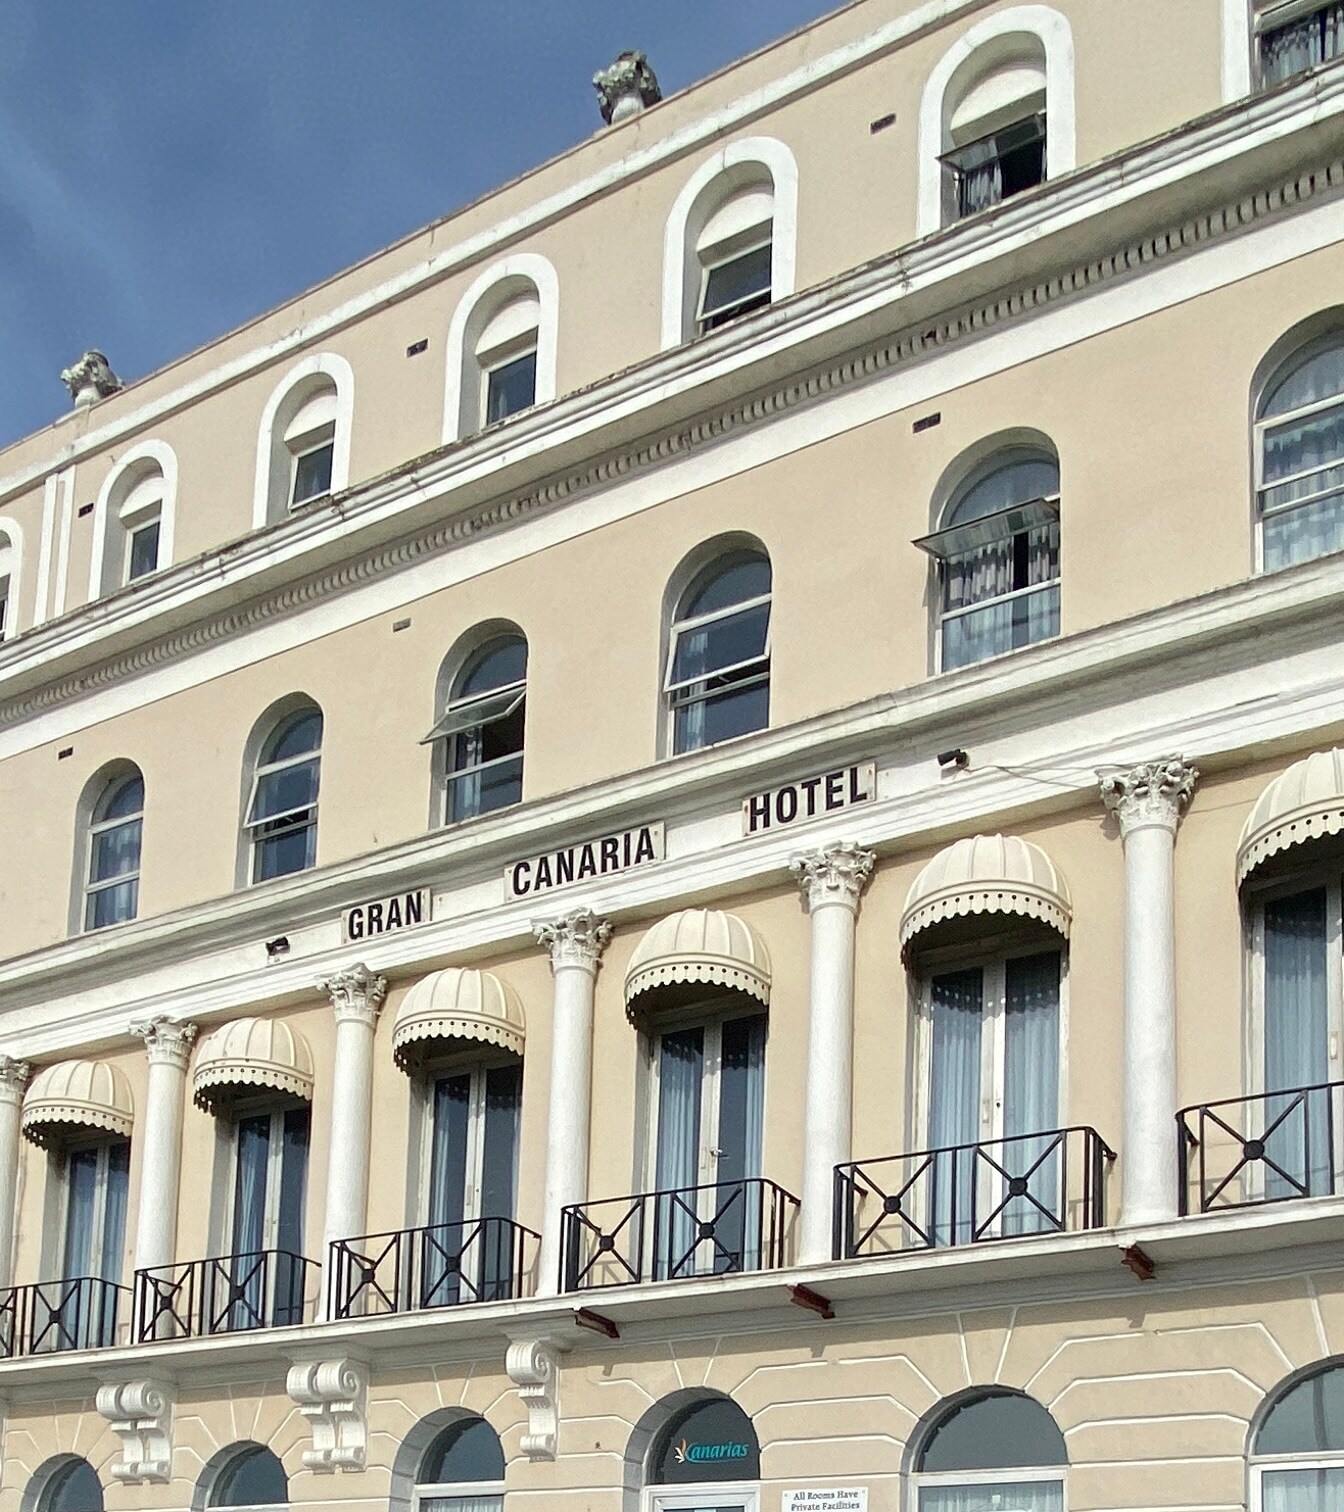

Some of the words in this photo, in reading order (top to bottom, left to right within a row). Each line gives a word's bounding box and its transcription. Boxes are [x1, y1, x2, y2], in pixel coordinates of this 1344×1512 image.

[347, 890, 424, 941] GRAN
[512, 828, 655, 896] CANARIA
[749, 767, 868, 833] HOTEL
[685, 1441, 749, 1464] Canarias
[793, 1492, 805, 1500] All
[807, 1492, 835, 1500] Rooms
[837, 1490, 858, 1499] Have
[791, 1503, 820, 1511] Private
[822, 1501, 860, 1510] Facilities
